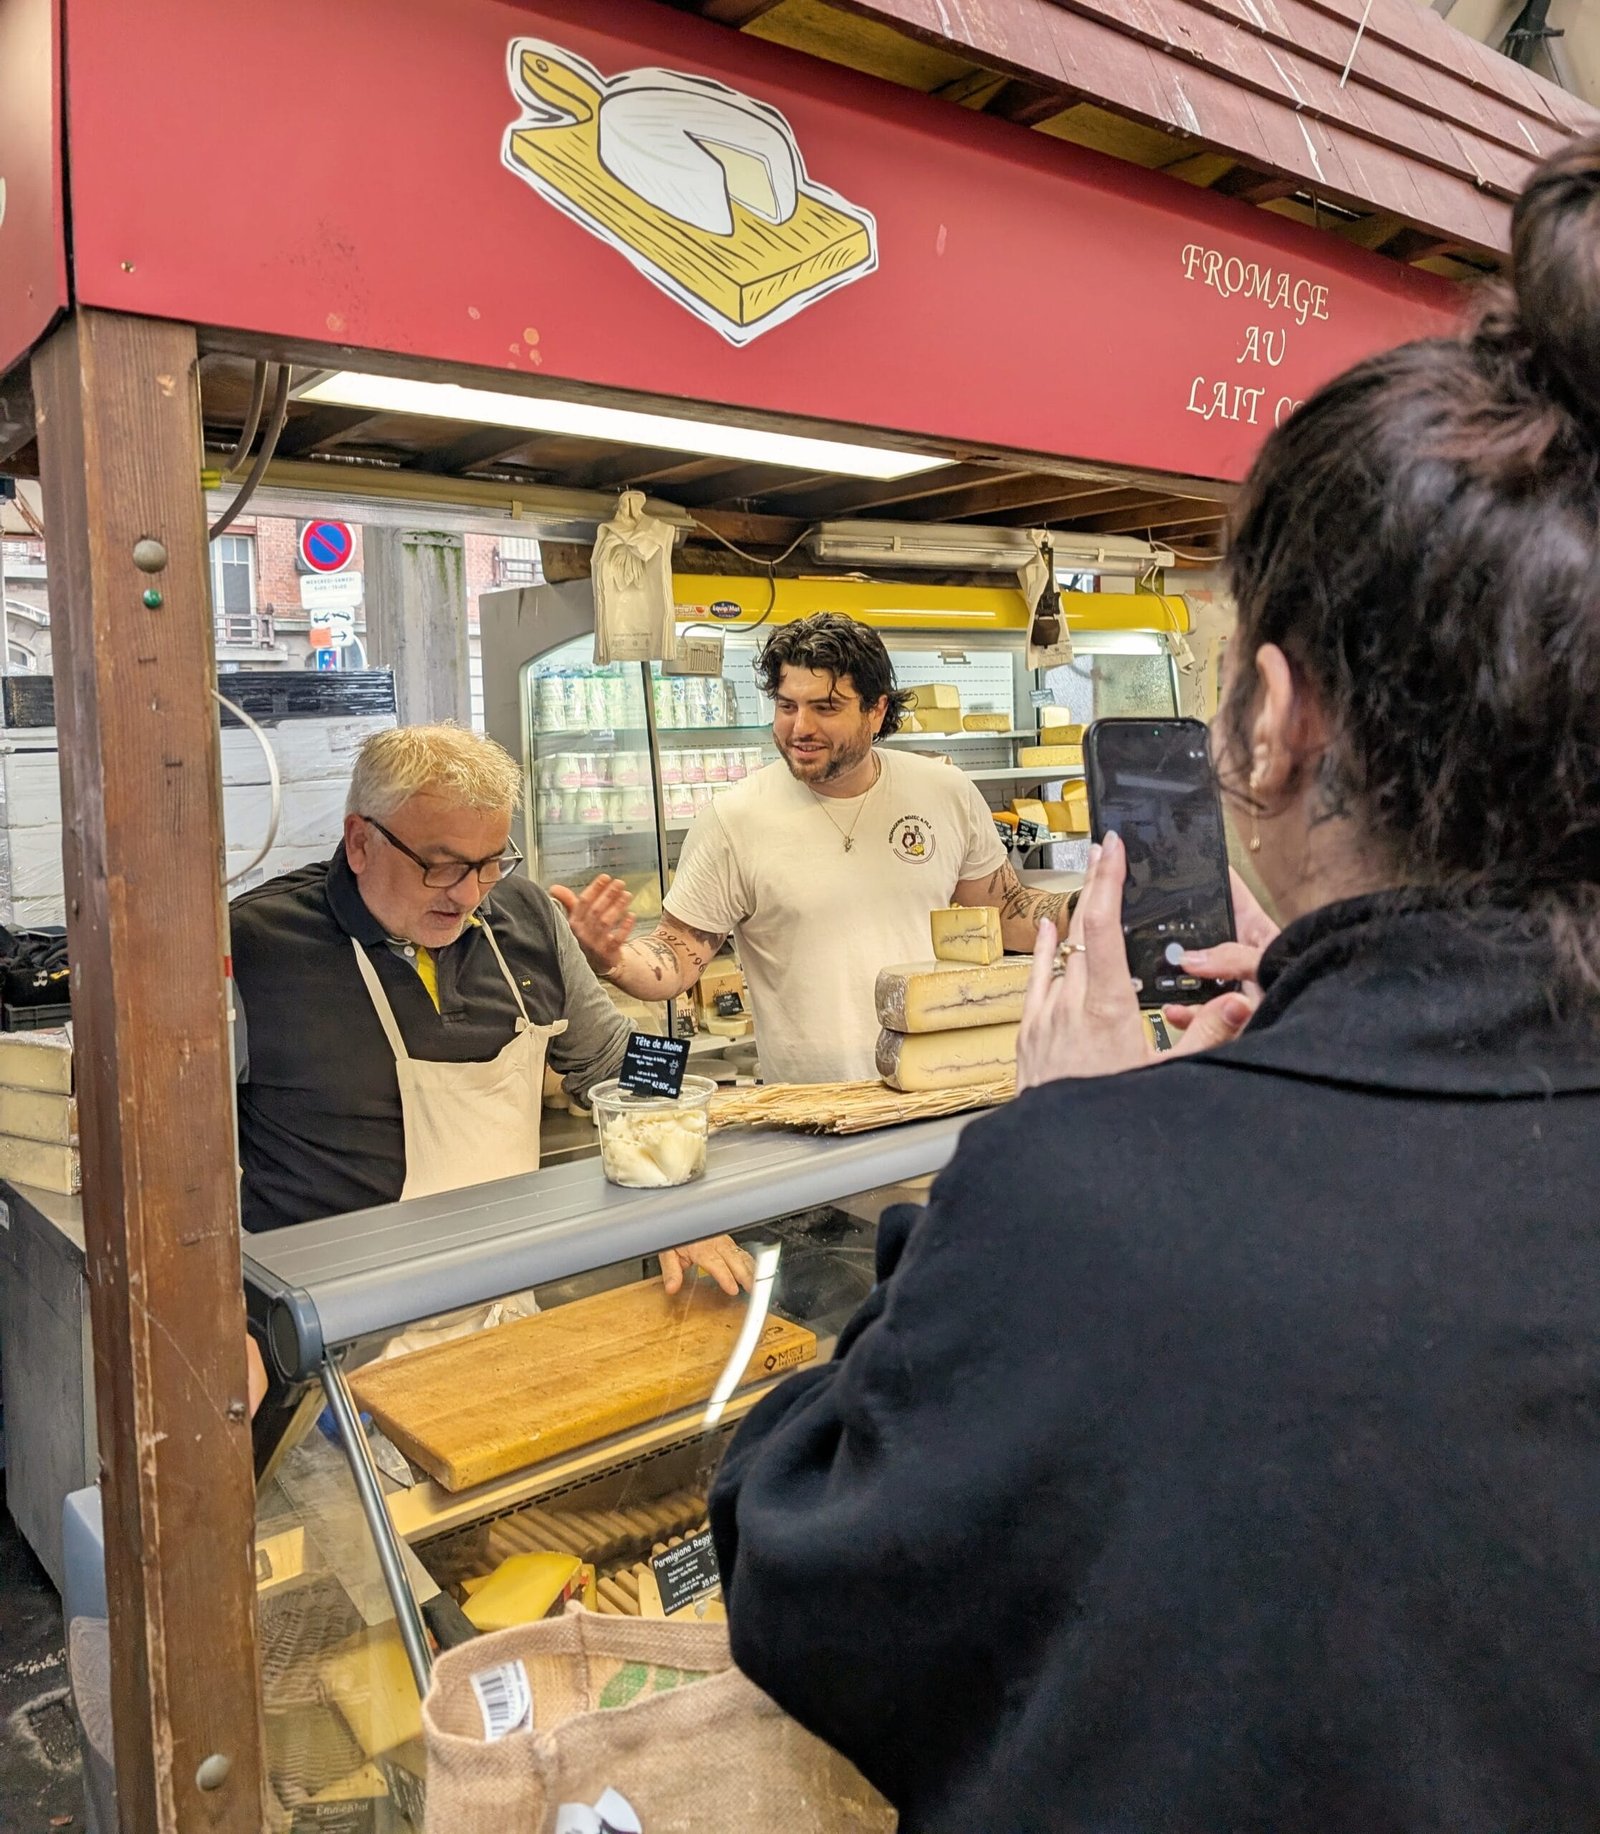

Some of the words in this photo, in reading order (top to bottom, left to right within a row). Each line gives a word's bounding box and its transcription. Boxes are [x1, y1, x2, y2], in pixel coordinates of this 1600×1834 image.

[1181, 243, 1329, 326] FROMAGE
[1236, 326, 1286, 367] AU
[1186, 376, 1265, 425] LAIT
[635, 1036, 651, 1048] Tête
[652, 1038, 662, 1049] de
[662, 1041, 684, 1053] Moine
[653, 1544, 692, 1570] Parmigiano
